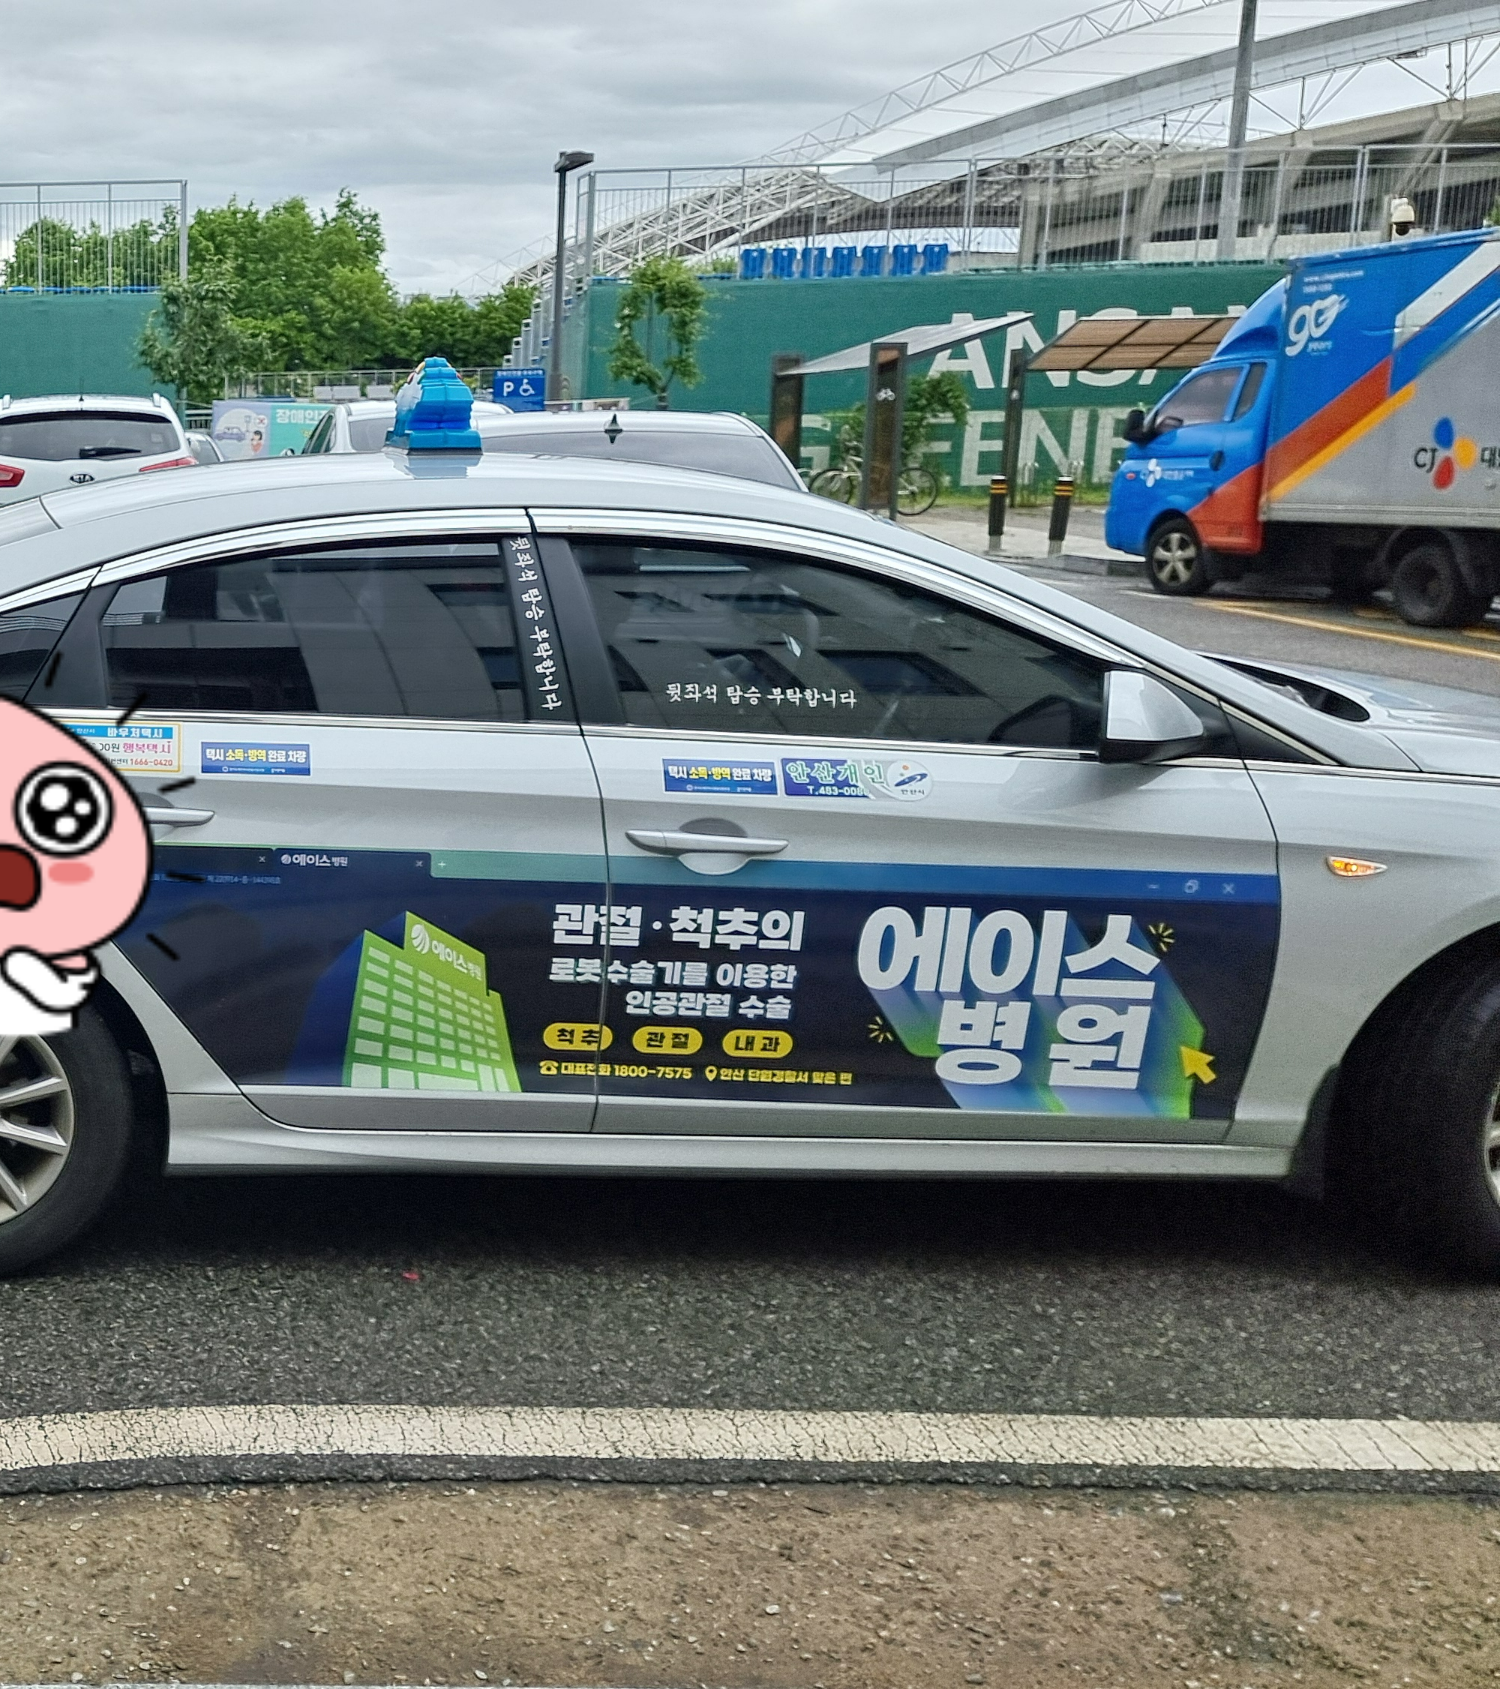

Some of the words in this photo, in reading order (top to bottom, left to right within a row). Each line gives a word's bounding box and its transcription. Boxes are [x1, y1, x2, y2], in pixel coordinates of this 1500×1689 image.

[503, 381, 514, 397] P
[276, 408, 328, 424] 장애인
[1414, 447, 1438, 474] CJ
[1480, 446, 1500, 468] 대
[509, 536, 539, 582] 뒷좌석
[521, 588, 545, 620] 탑승
[529, 625, 563, 711] 부탁합니다
[666, 682, 717, 703] 뒷좌석
[726, 685, 762, 706] 탑승
[767, 687, 857, 709] 부탁합니다
[107, 727, 163, 738] 바우처택시
[122, 741, 172, 754] 행복택시
[205, 748, 224, 761] 택시
[268, 750, 286, 762] 완료
[287, 750, 307, 763] 차량
[130, 758, 173, 766] 1666-0420
[668, 765, 688, 779] 택시
[731, 767, 751, 781] 완료
[752, 768, 773, 782] 차량
[786, 760, 885, 785] 안산개인
[857, 906, 1161, 1000] 에이스
[716, 962, 797, 990] 이용한
[625, 990, 731, 1017] 인공관절
[738, 995, 792, 1020] 수술
[646, 1031, 690, 1049] 관절
[734, 1034, 780, 1053] 내과
[935, 1000, 1151, 1089] 병원
[561, 1062, 611, 1077] 대표전화
[614, 1064, 692, 1080] 1800-7575
[719, 1068, 745, 1081] 안산
